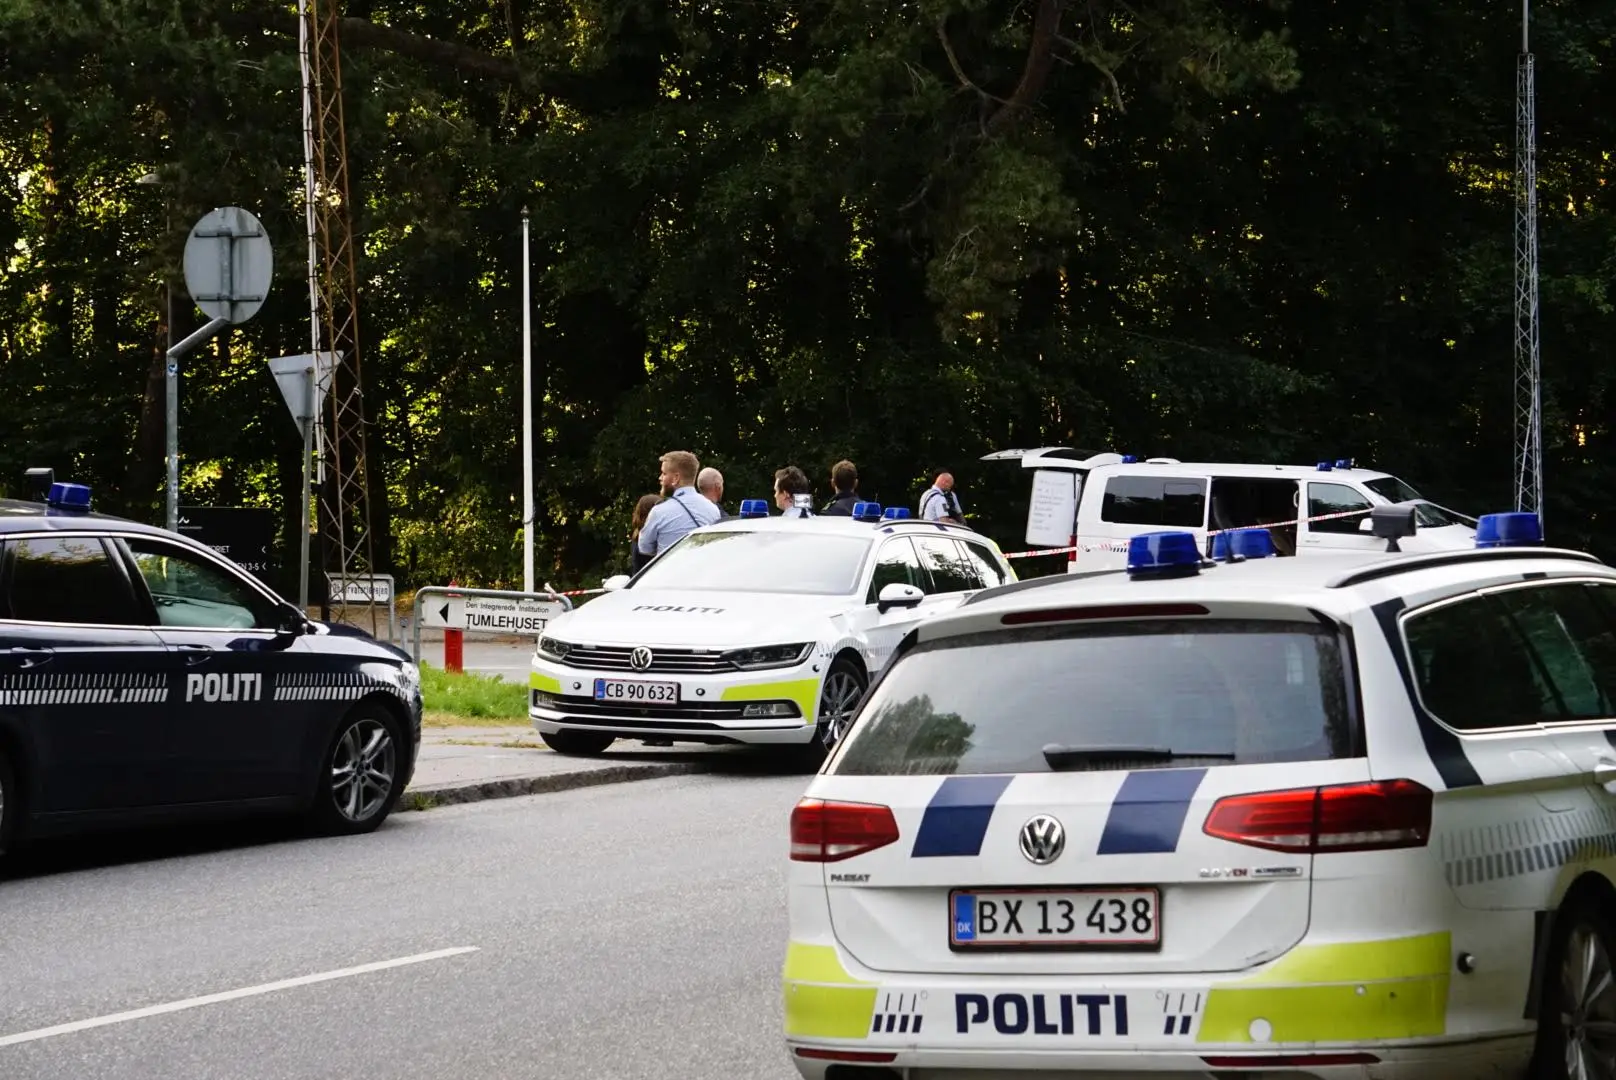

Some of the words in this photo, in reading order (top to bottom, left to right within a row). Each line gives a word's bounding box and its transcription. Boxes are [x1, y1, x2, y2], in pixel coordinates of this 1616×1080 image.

[465, 601, 478, 610] Den
[518, 604, 550, 614] Institution
[632, 605, 726, 615] POLITI
[465, 613, 549, 630] TUMLEHUSET
[185, 673, 263, 703] POLITI
[606, 683, 624, 698] CB
[627, 684, 645, 699] 90
[648, 685, 675, 701] 632
[978, 900, 1024, 934] BX
[1036, 899, 1075, 934] 13
[1086, 898, 1152, 934] 438
[957, 923, 972, 933] DK
[955, 993, 1129, 1036] POLITI
